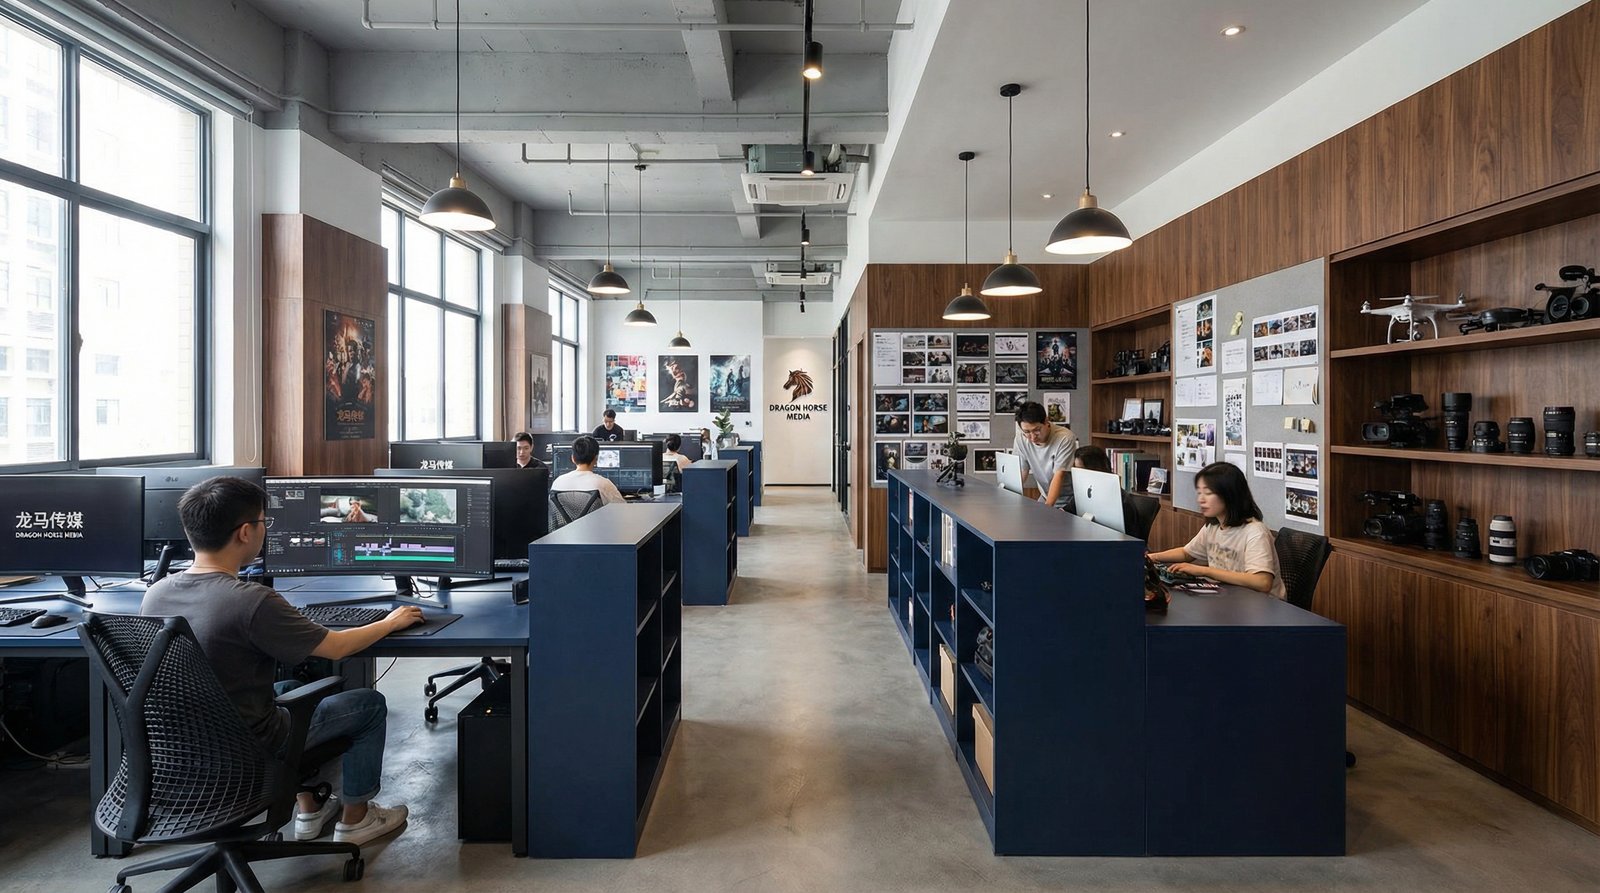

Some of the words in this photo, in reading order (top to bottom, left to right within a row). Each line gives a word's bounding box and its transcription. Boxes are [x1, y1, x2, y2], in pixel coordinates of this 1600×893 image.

[769, 404, 801, 412] DRAGON
[802, 404, 828, 412] HORSE
[15, 511, 84, 529] 龙马传媒
[15, 531, 42, 539] DRAGON
